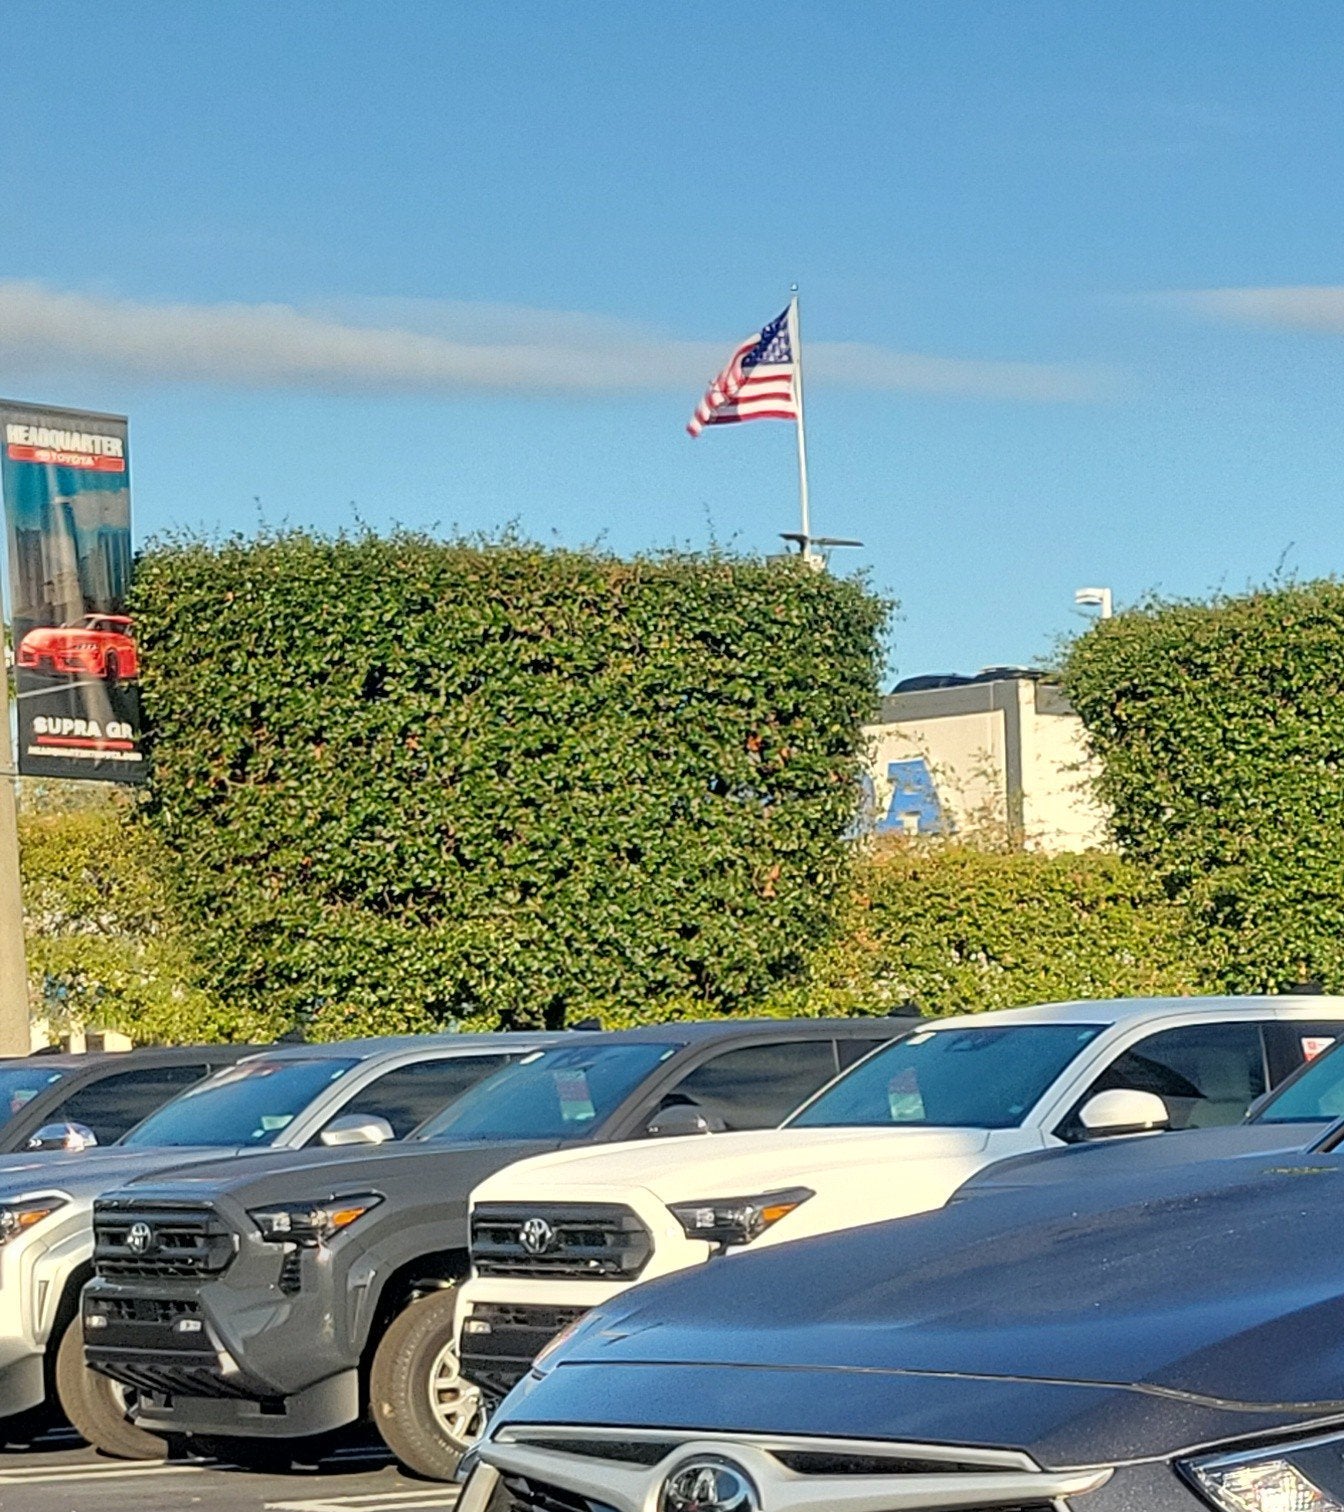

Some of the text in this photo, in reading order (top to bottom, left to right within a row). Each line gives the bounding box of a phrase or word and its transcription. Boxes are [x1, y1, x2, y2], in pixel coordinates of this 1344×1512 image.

[6, 423, 123, 458] HEADQUARTER
[33, 716, 134, 739] SUPRA GR
